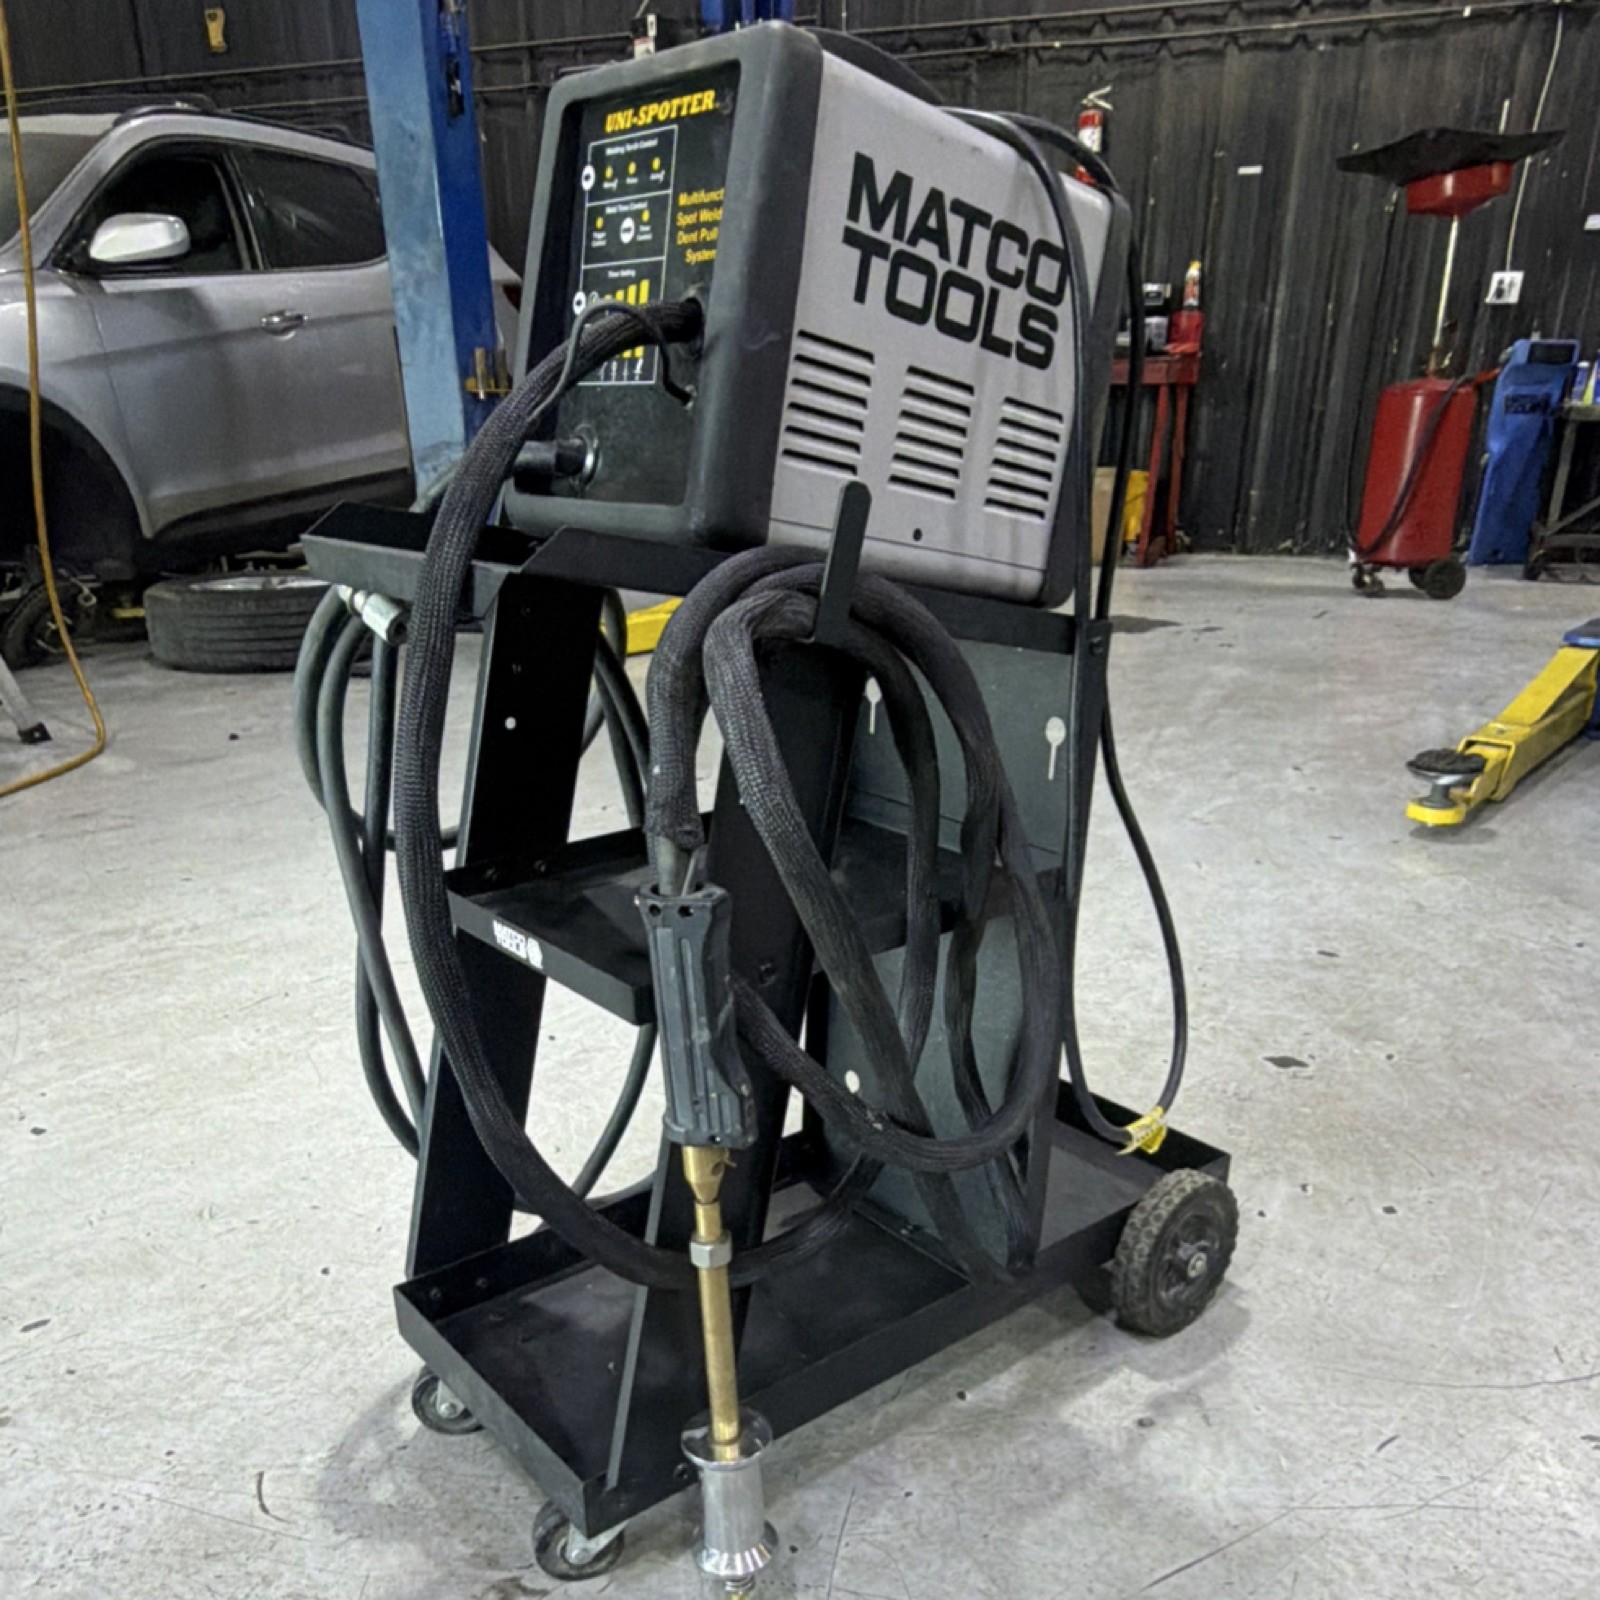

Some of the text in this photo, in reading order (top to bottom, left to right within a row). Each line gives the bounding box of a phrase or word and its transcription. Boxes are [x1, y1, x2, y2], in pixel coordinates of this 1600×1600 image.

[605, 90, 716, 133] UNI-SPOTTER
[676, 210, 697, 228] Spot
[676, 230, 698, 245] Dent
[846, 151, 1068, 307] MATCO
[842, 225, 1059, 370] TOOLS
